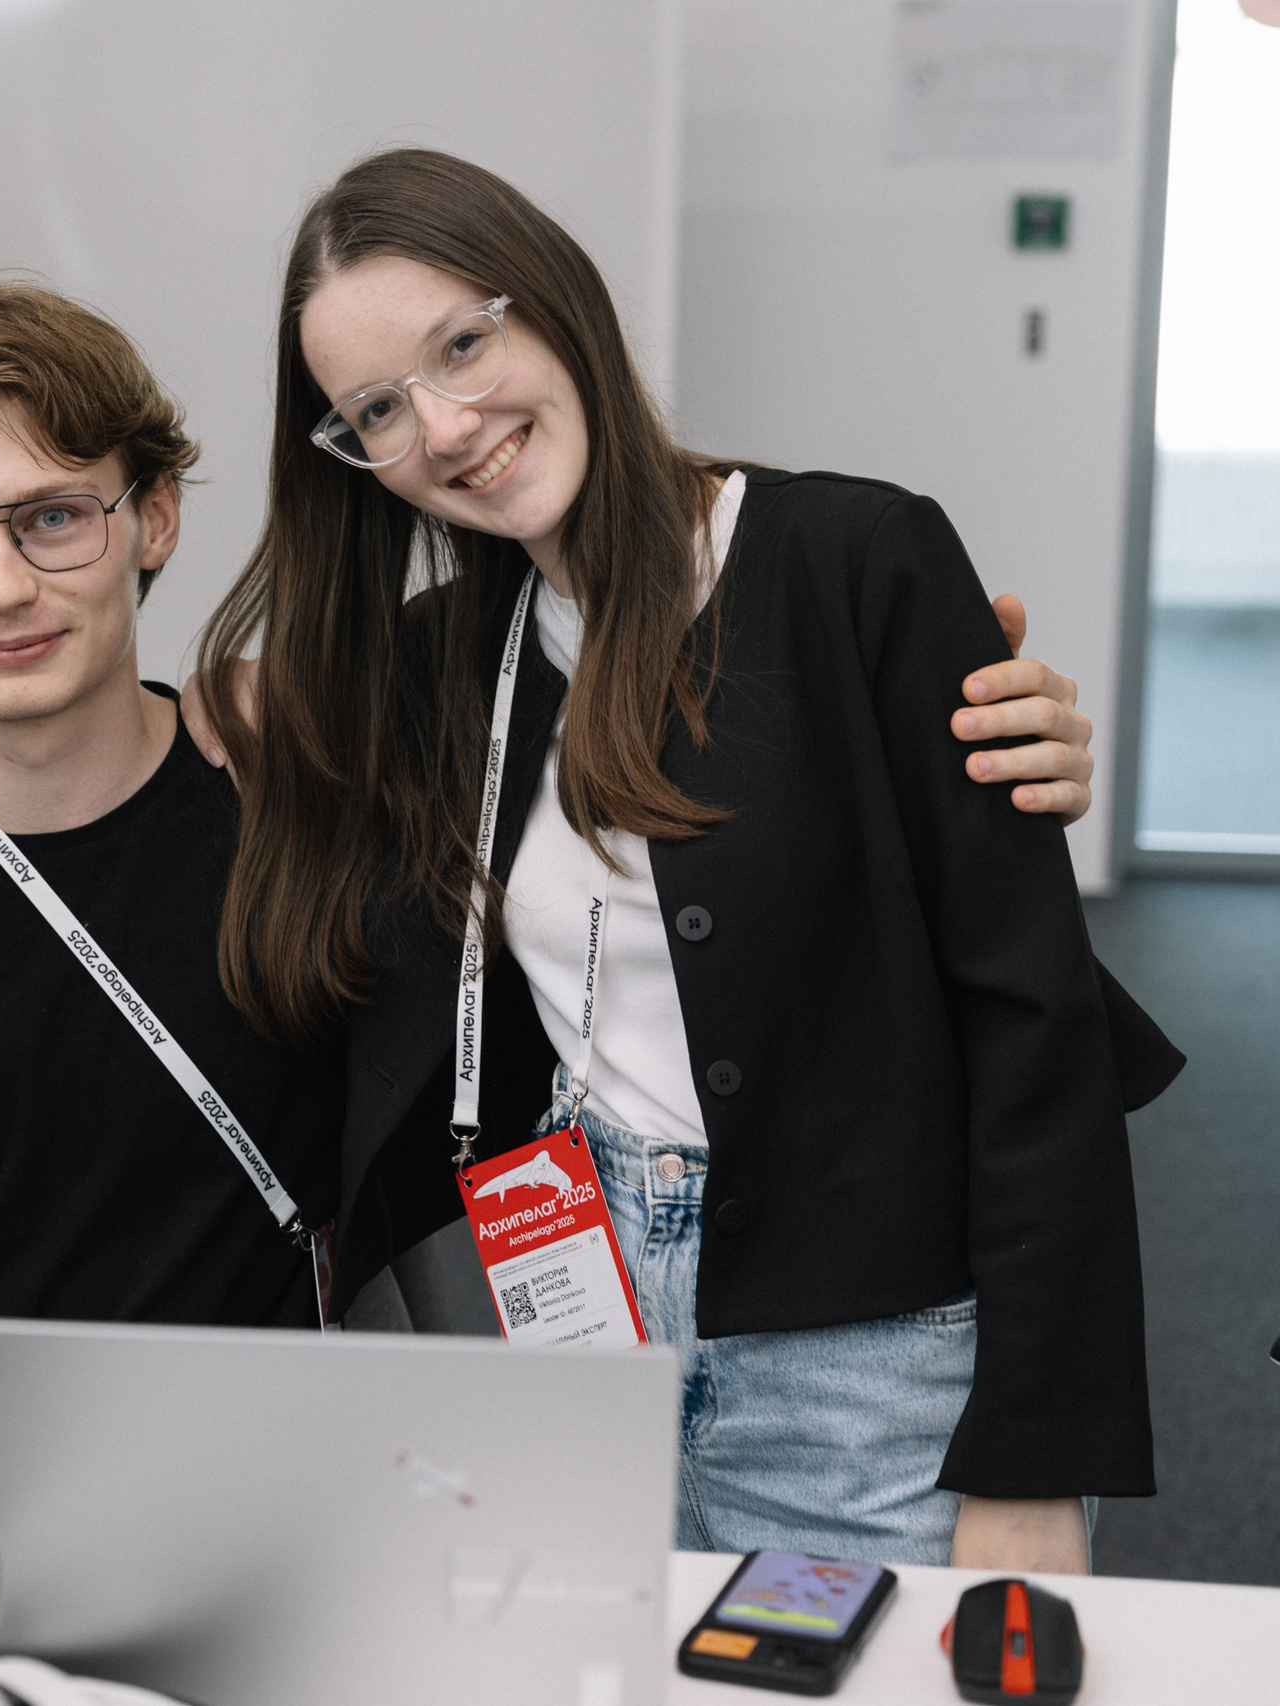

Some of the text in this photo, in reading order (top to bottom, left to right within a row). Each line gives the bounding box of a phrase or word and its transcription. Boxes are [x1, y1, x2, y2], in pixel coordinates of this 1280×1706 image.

[67, 929, 167, 1045] Archipelago'2025
[581, 896, 604, 1040] Архипелаг'2025
[458, 943, 479, 1083] Архипелаг'2025
[197, 1089, 276, 1192] Архипелаг'2025
[478, 1181, 596, 1241] Архипелаг'2025
[508, 1213, 576, 1247] Archipelago'2025
[531, 1265, 569, 1286] ВИКТОРИЯ
[535, 1277, 572, 1298] ДАНКОВА
[560, 1287, 586, 1302] Dankova
[580, 1320, 608, 1337] ЭКСПЕРТ
